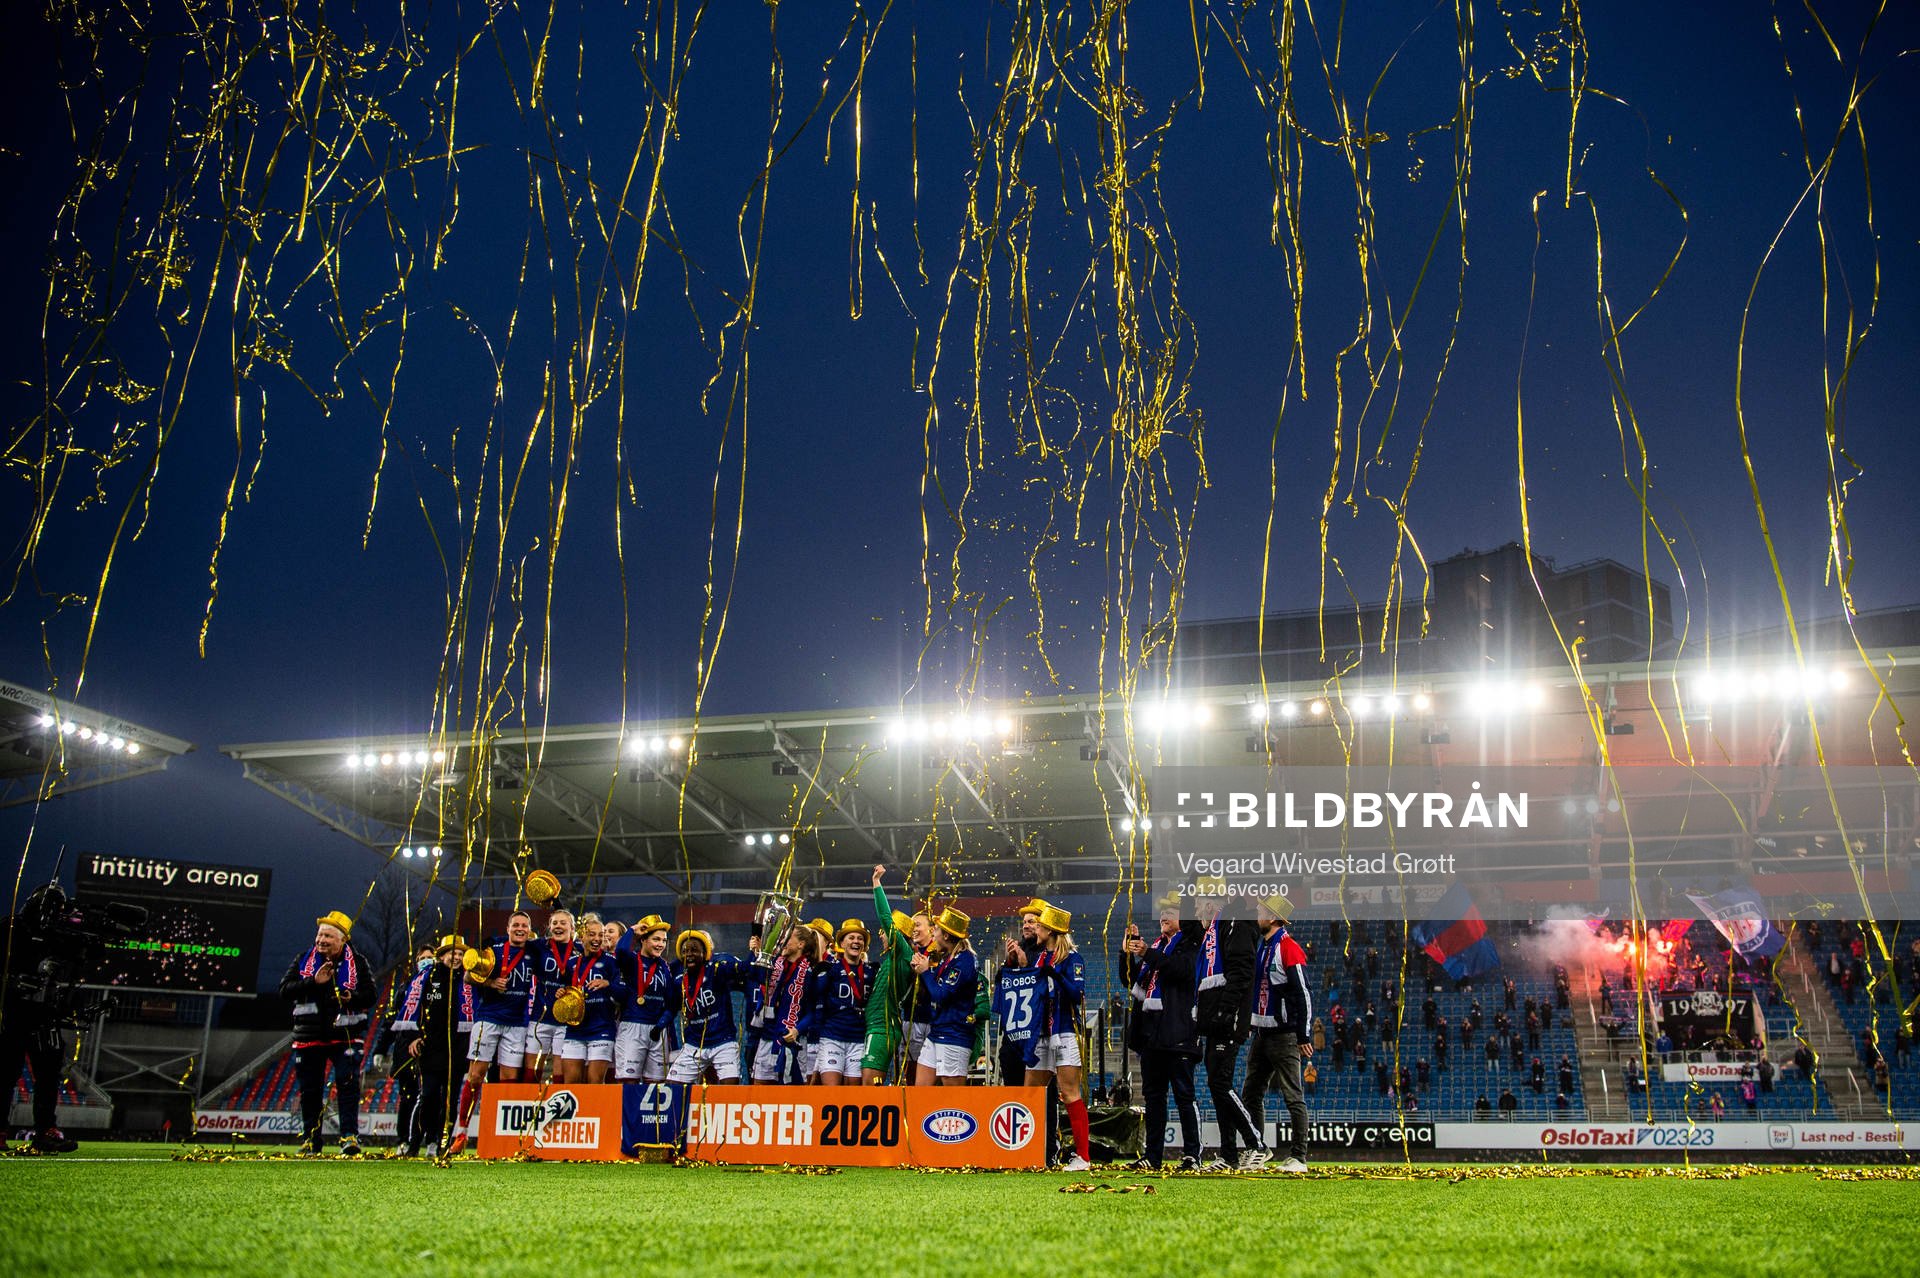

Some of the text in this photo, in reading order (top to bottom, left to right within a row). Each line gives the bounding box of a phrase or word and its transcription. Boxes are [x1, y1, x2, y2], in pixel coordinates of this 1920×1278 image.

[1, 686, 23, 699] NRC
[92, 855, 259, 888] intility arena
[206, 945, 241, 957] 2020
[1012, 976, 1037, 987] OBOS
[1005, 988, 1034, 1031] 23
[1688, 1065, 1742, 1076] OsloTax
[640, 1083, 672, 1111] 25
[198, 1115, 303, 1132] OsloTaxi 0232
[501, 1105, 546, 1131] TOPP
[687, 1103, 900, 1147] EMESTER 2020
[541, 1121, 595, 1144] SERIEN
[1541, 1128, 1714, 1146] OsloTaxi 02323
[1802, 1132, 1826, 1142] Last
[1830, 1131, 1854, 1142] ned
